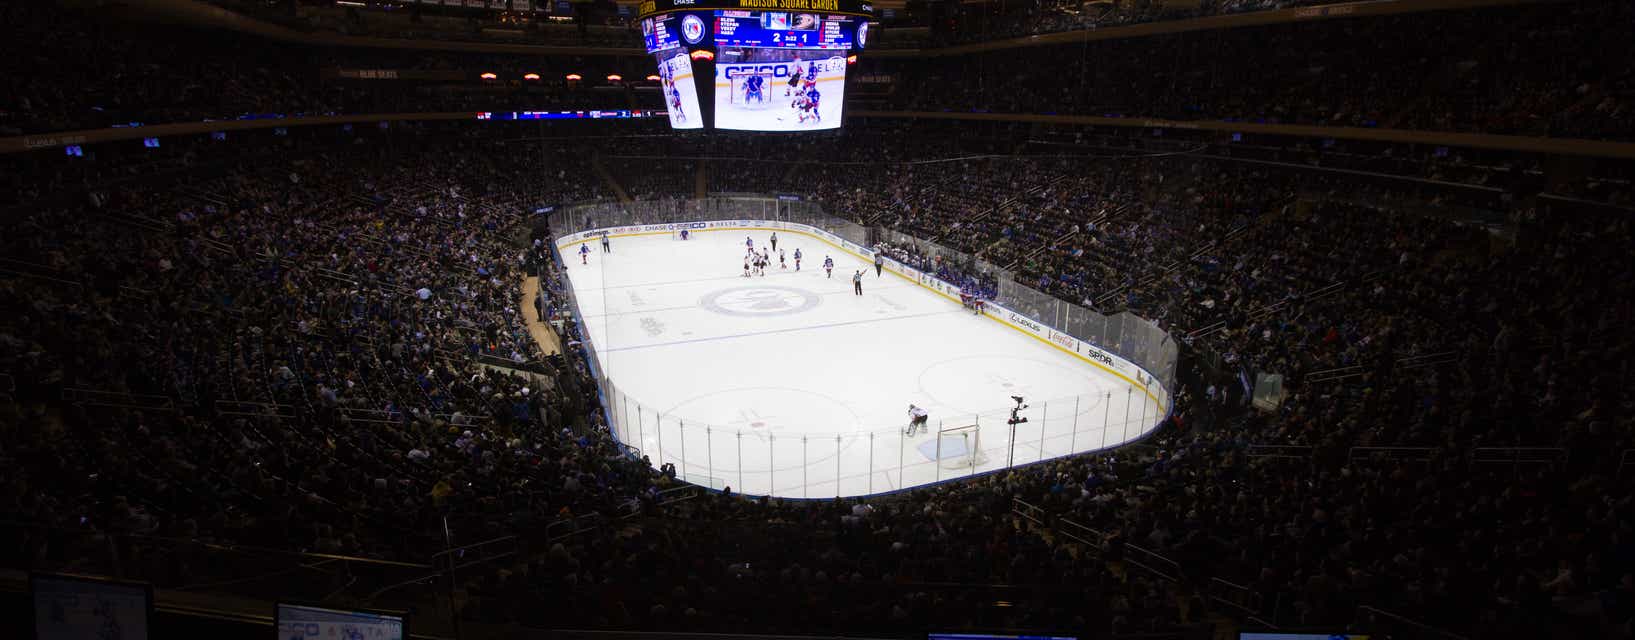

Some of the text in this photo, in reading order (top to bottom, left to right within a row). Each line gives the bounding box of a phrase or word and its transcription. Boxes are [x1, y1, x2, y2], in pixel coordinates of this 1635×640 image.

[740, 0, 839, 11] MADISON SQUARE GARDEN
[773, 33, 781, 42] 2
[801, 33, 808, 43] 1
[725, 64, 788, 79] GEICO
[645, 224, 667, 232] CHASE
[1016, 316, 1041, 332] LEXUS
